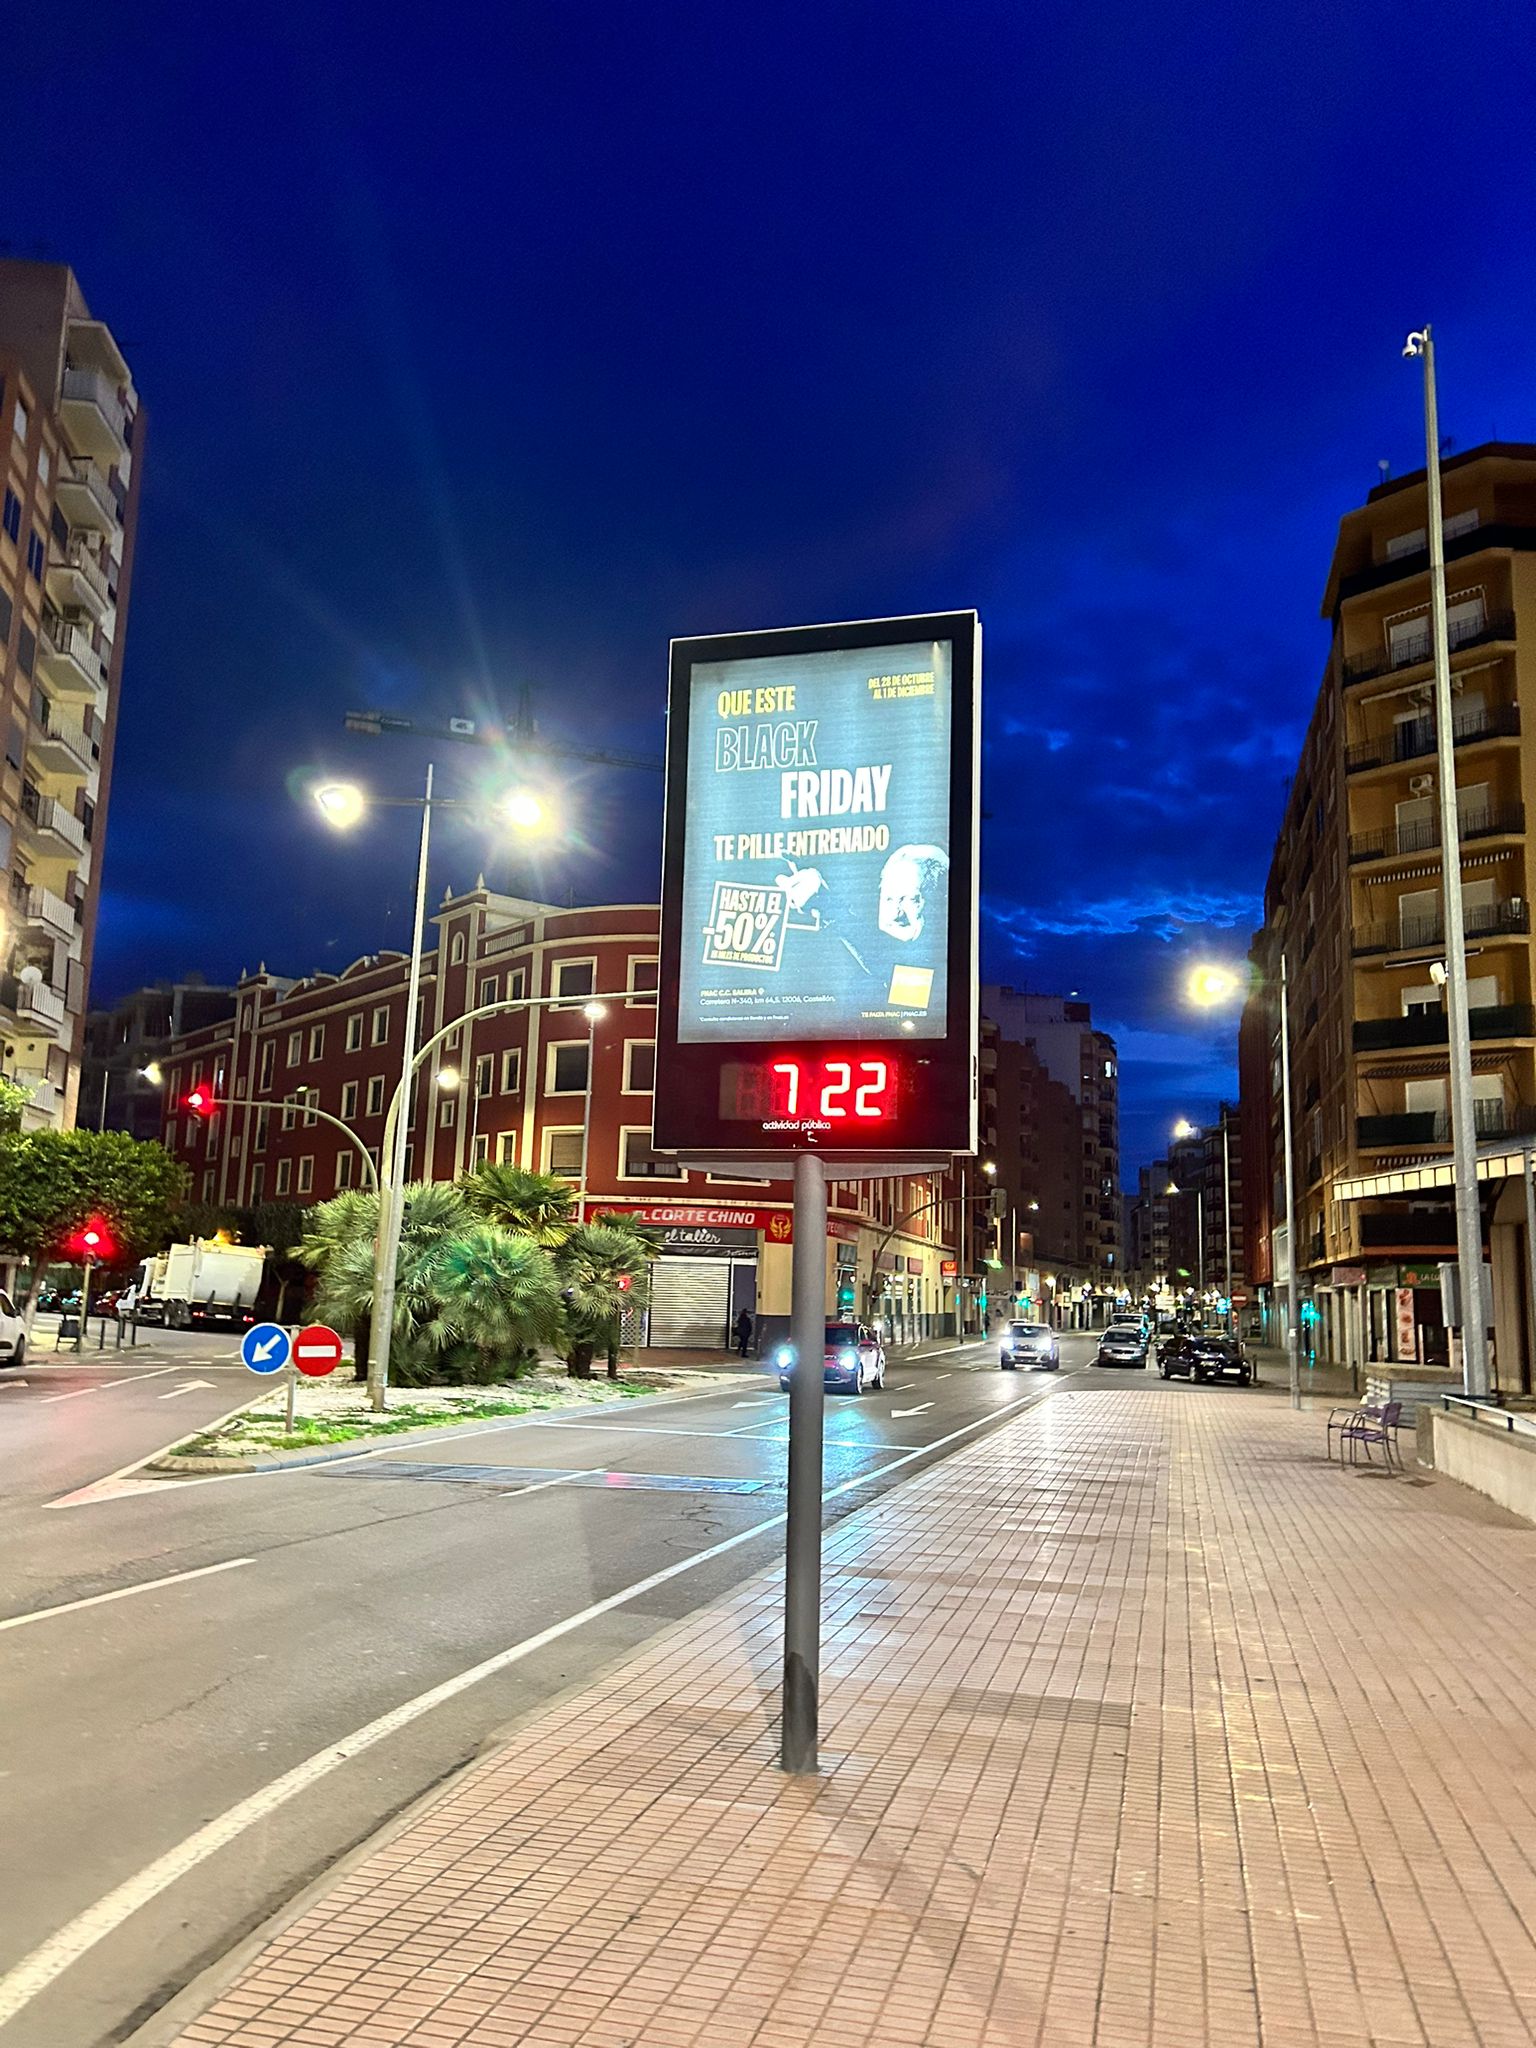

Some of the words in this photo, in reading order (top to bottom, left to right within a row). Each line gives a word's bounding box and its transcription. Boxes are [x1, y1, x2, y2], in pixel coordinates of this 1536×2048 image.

[868, 677, 880, 689] DEL
[891, 674, 901, 686] DE
[901, 671, 935, 685] OCTUBRE
[718, 688, 752, 719] QUE
[755, 685, 796, 714] ESTE
[873, 687, 883, 700] AL
[887, 686, 897, 698] DE
[897, 683, 935, 698] DICIEMBRE
[715, 720, 818, 772] BLACK
[780, 764, 892, 819] FRIDAY
[713, 835, 735, 861] TE
[737, 832, 784, 860] PILLE
[787, 824, 890, 857] ENTRENADO
[719, 888, 766, 913] HASTA
[766, 892, 782, 915] EL
[762, 1119, 800, 1130] actividad
[801, 1119, 831, 1131] pública
[650, 1209, 708, 1222] CORTE
[708, 1209, 756, 1225] CHINO
[664, 1228, 678, 1243] el
